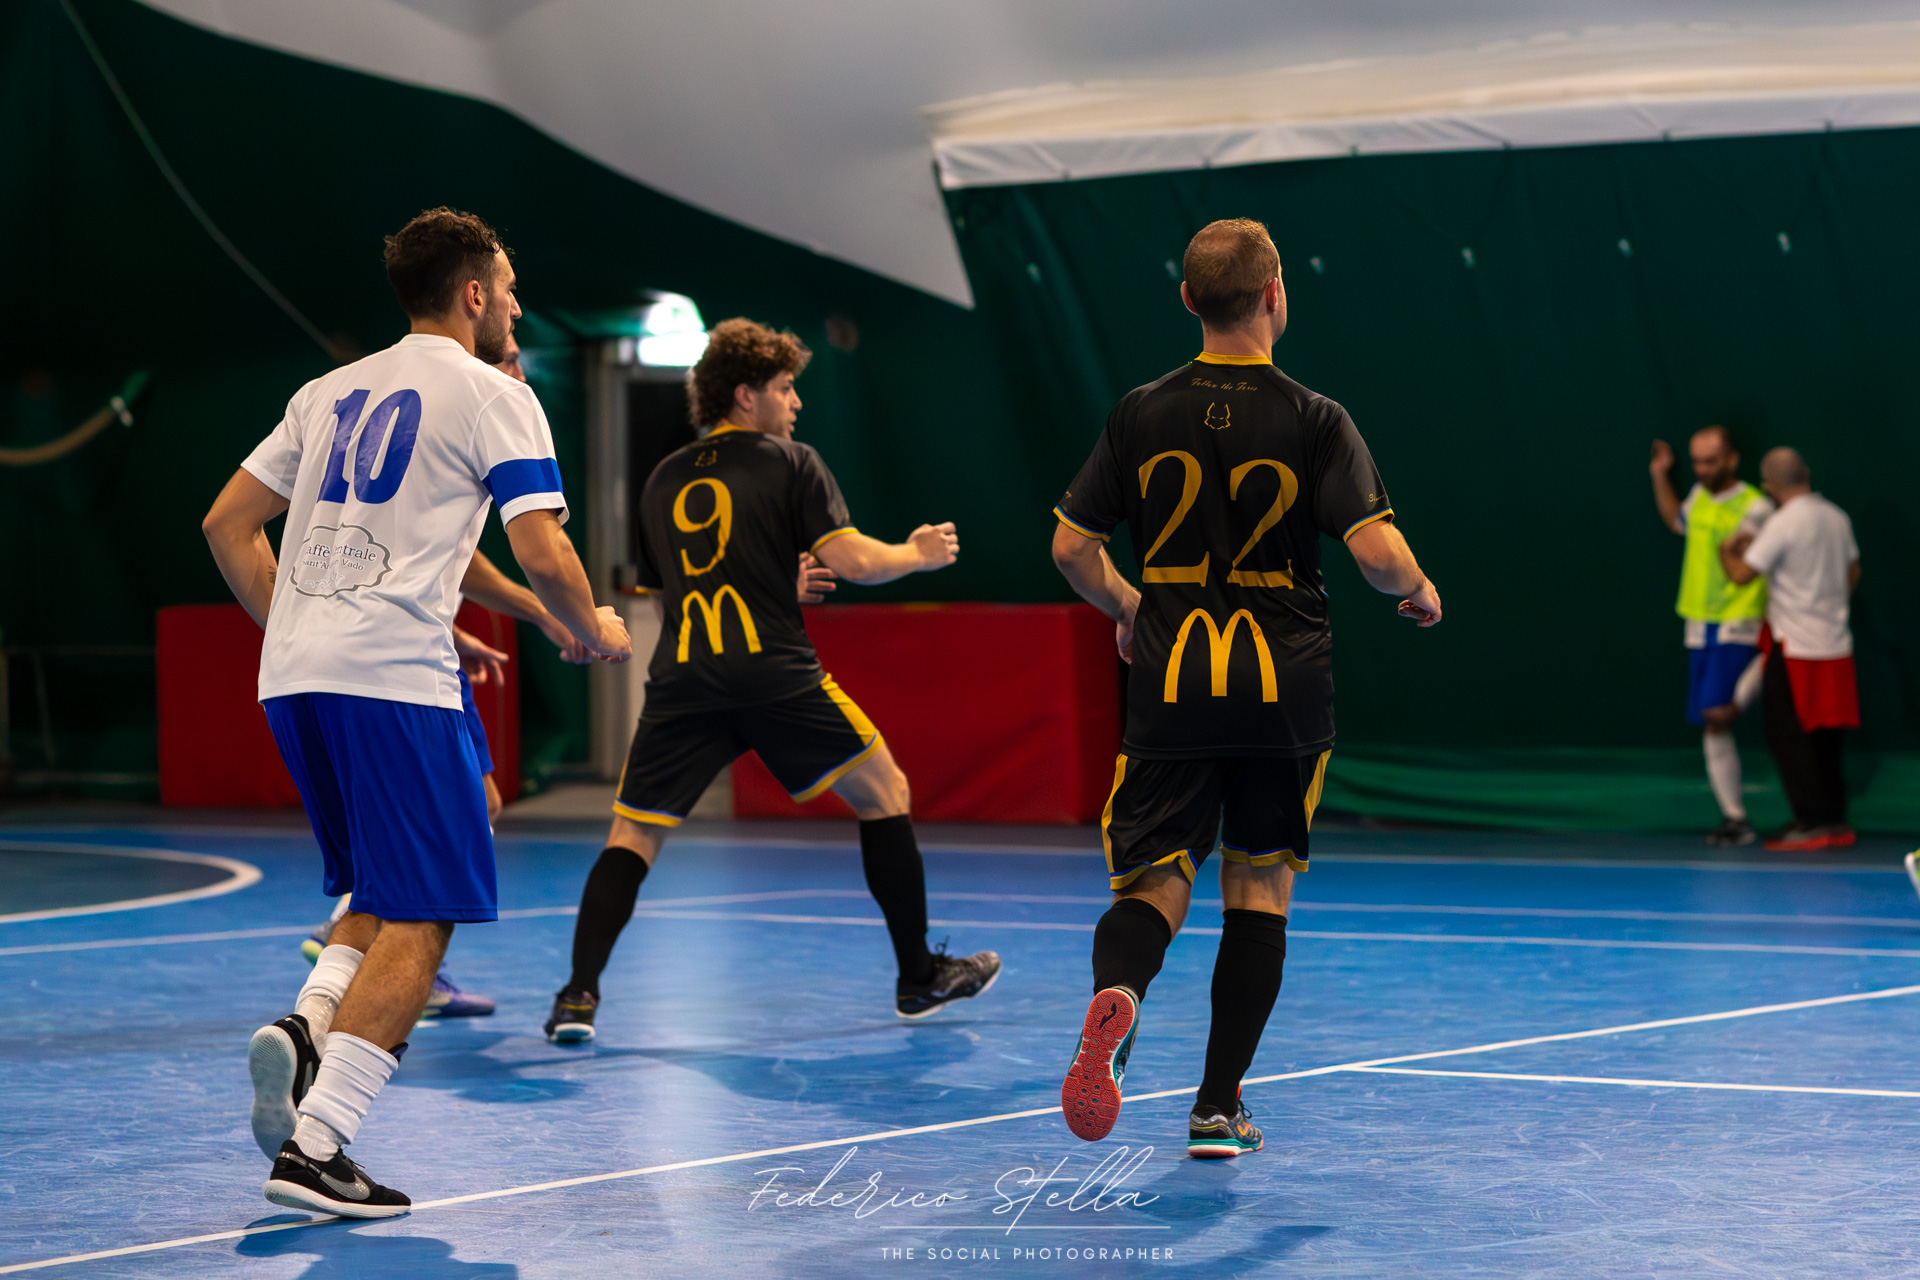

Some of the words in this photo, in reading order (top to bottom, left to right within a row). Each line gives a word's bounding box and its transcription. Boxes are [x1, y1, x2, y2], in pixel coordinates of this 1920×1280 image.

[1191, 377, 1218, 389] Follow
[1220, 381, 1233, 390] the
[317, 389, 422, 504] 10
[341, 558, 364, 571] Vado
[672, 477, 733, 577] 9
[1138, 449, 1299, 590] 22
